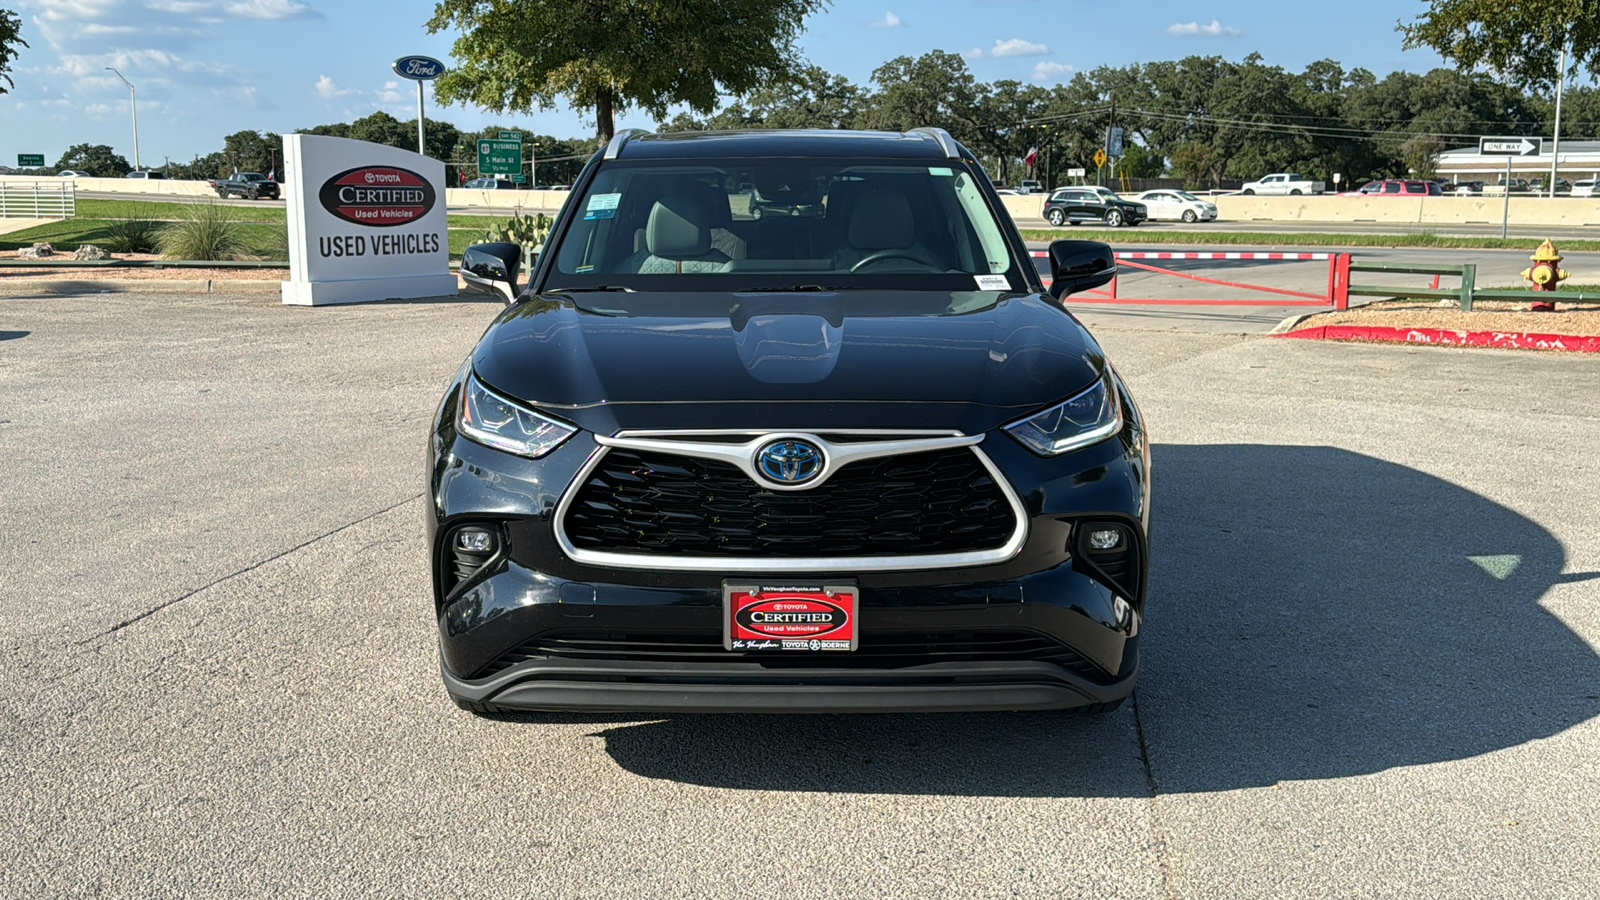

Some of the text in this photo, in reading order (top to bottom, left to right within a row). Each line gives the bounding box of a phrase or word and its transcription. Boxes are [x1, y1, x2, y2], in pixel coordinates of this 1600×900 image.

[406, 59, 436, 76] Ford
[375, 174, 401, 183] TOYOTA
[338, 186, 425, 203] CERTIFIED
[355, 209, 413, 219] Used Vehicles
[319, 233, 439, 258] USED VEHICLES
[750, 611, 833, 623] CERTIFIED
[732, 640, 745, 648] Vic
